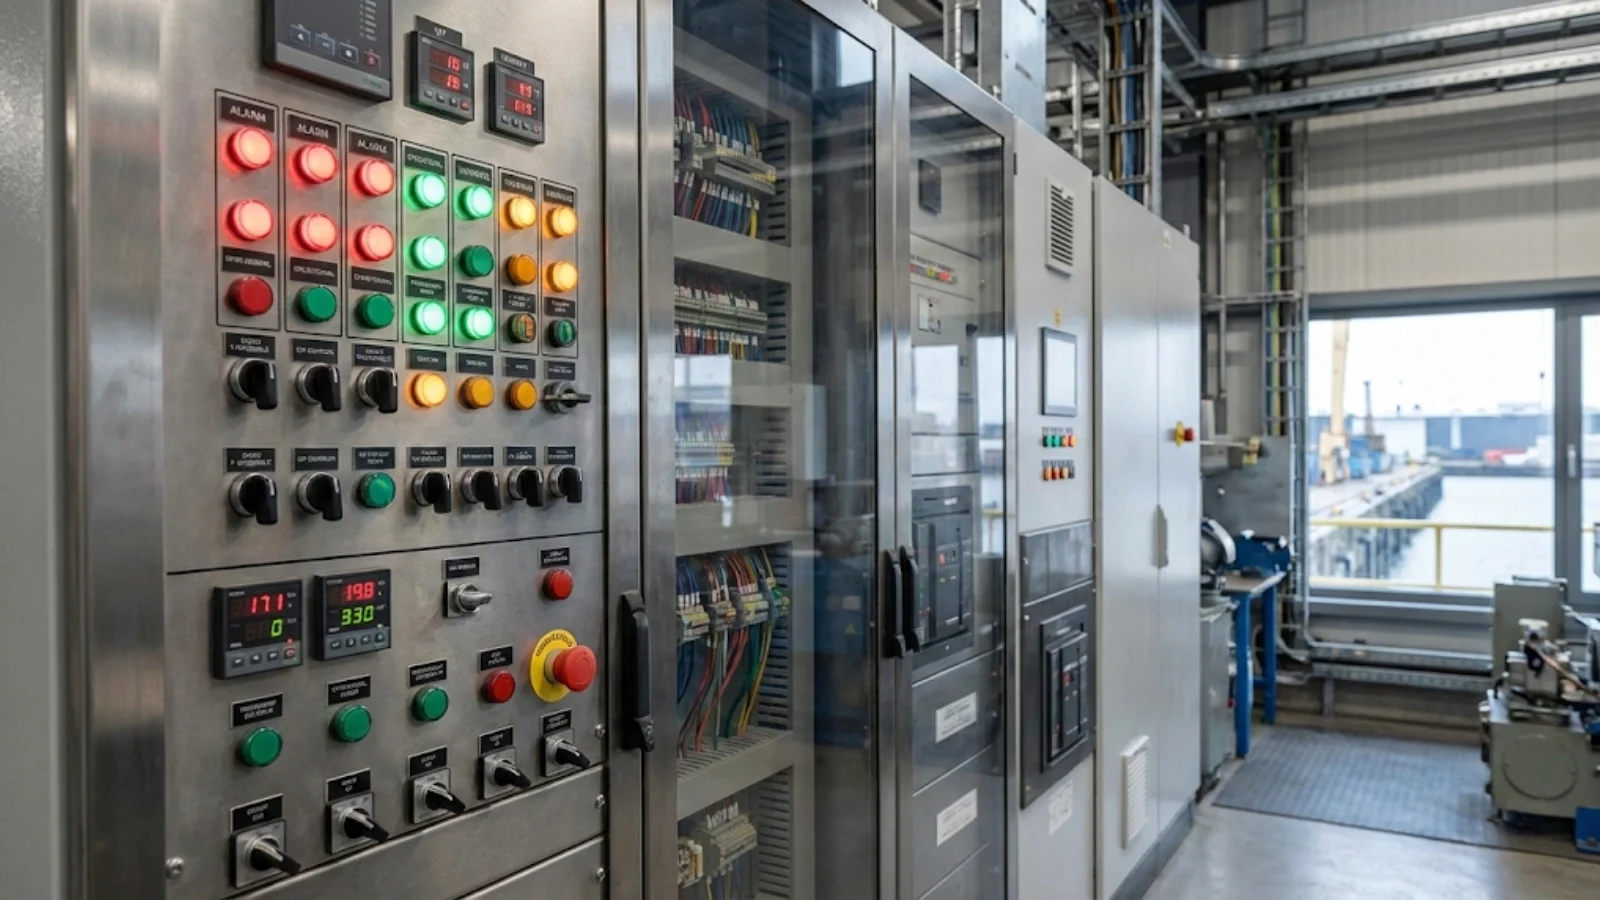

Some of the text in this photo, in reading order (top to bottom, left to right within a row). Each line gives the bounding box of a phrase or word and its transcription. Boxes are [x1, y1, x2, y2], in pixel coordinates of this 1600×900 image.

[230, 105, 267, 123] ALARM
[251, 594, 284, 614] 171
[341, 605, 375, 626] 330
